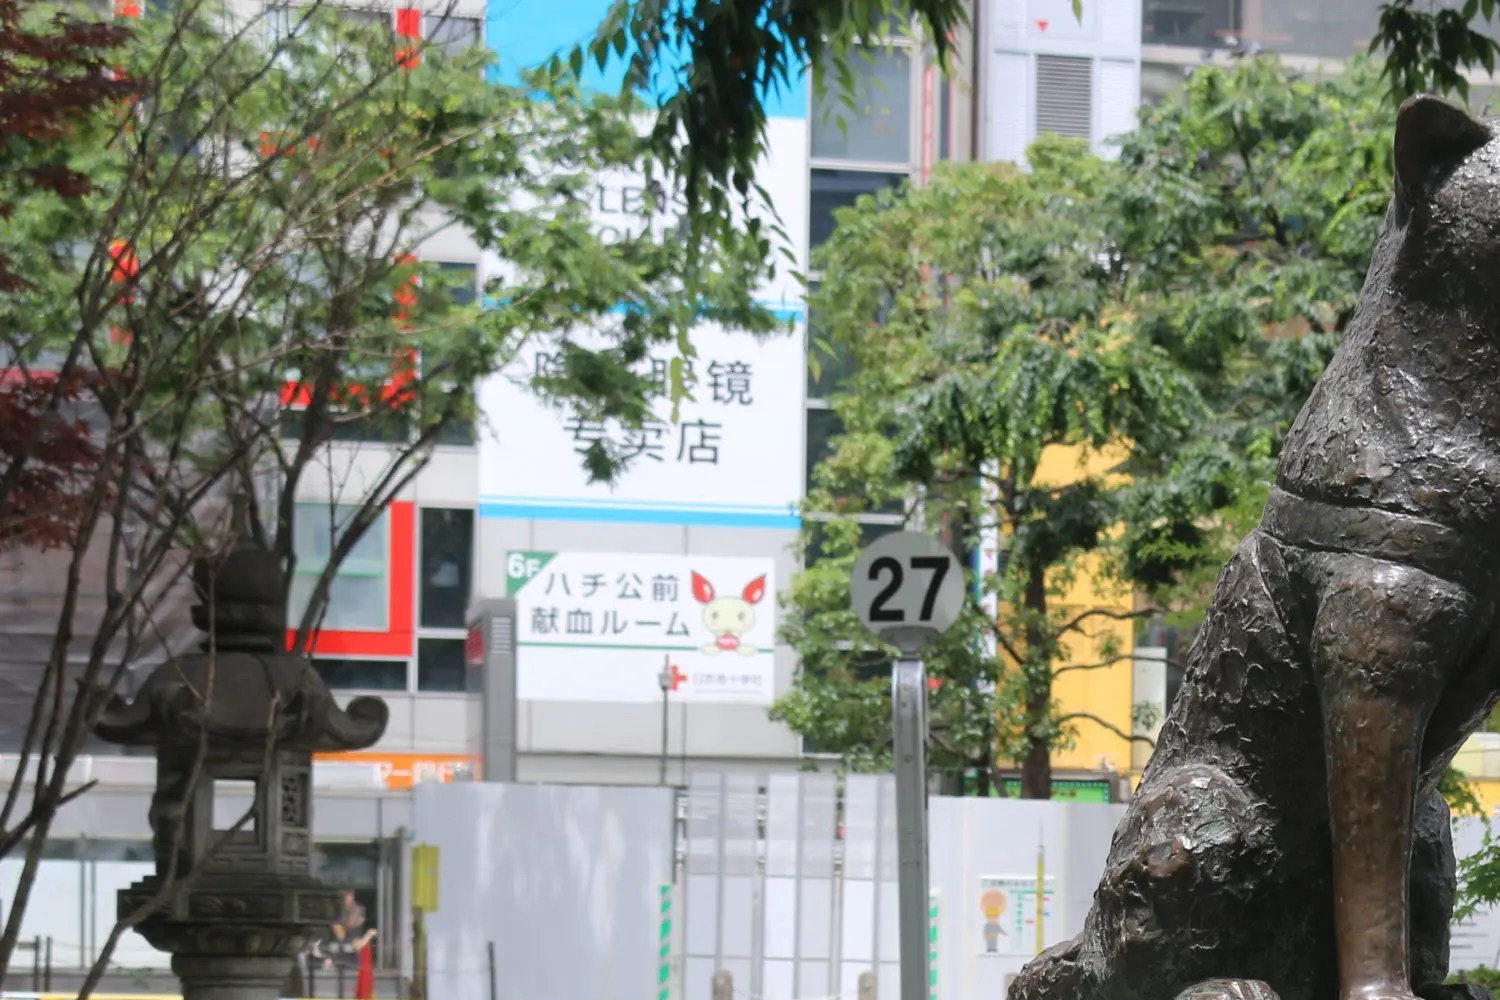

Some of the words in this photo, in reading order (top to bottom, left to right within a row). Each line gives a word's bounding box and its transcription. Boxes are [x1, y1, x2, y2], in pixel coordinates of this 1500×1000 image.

[507, 553, 541, 579] 6F
[544, 572, 680, 602] ハチ公前
[868, 556, 950, 622] 27
[530, 607, 690, 637] 献血ルーム
